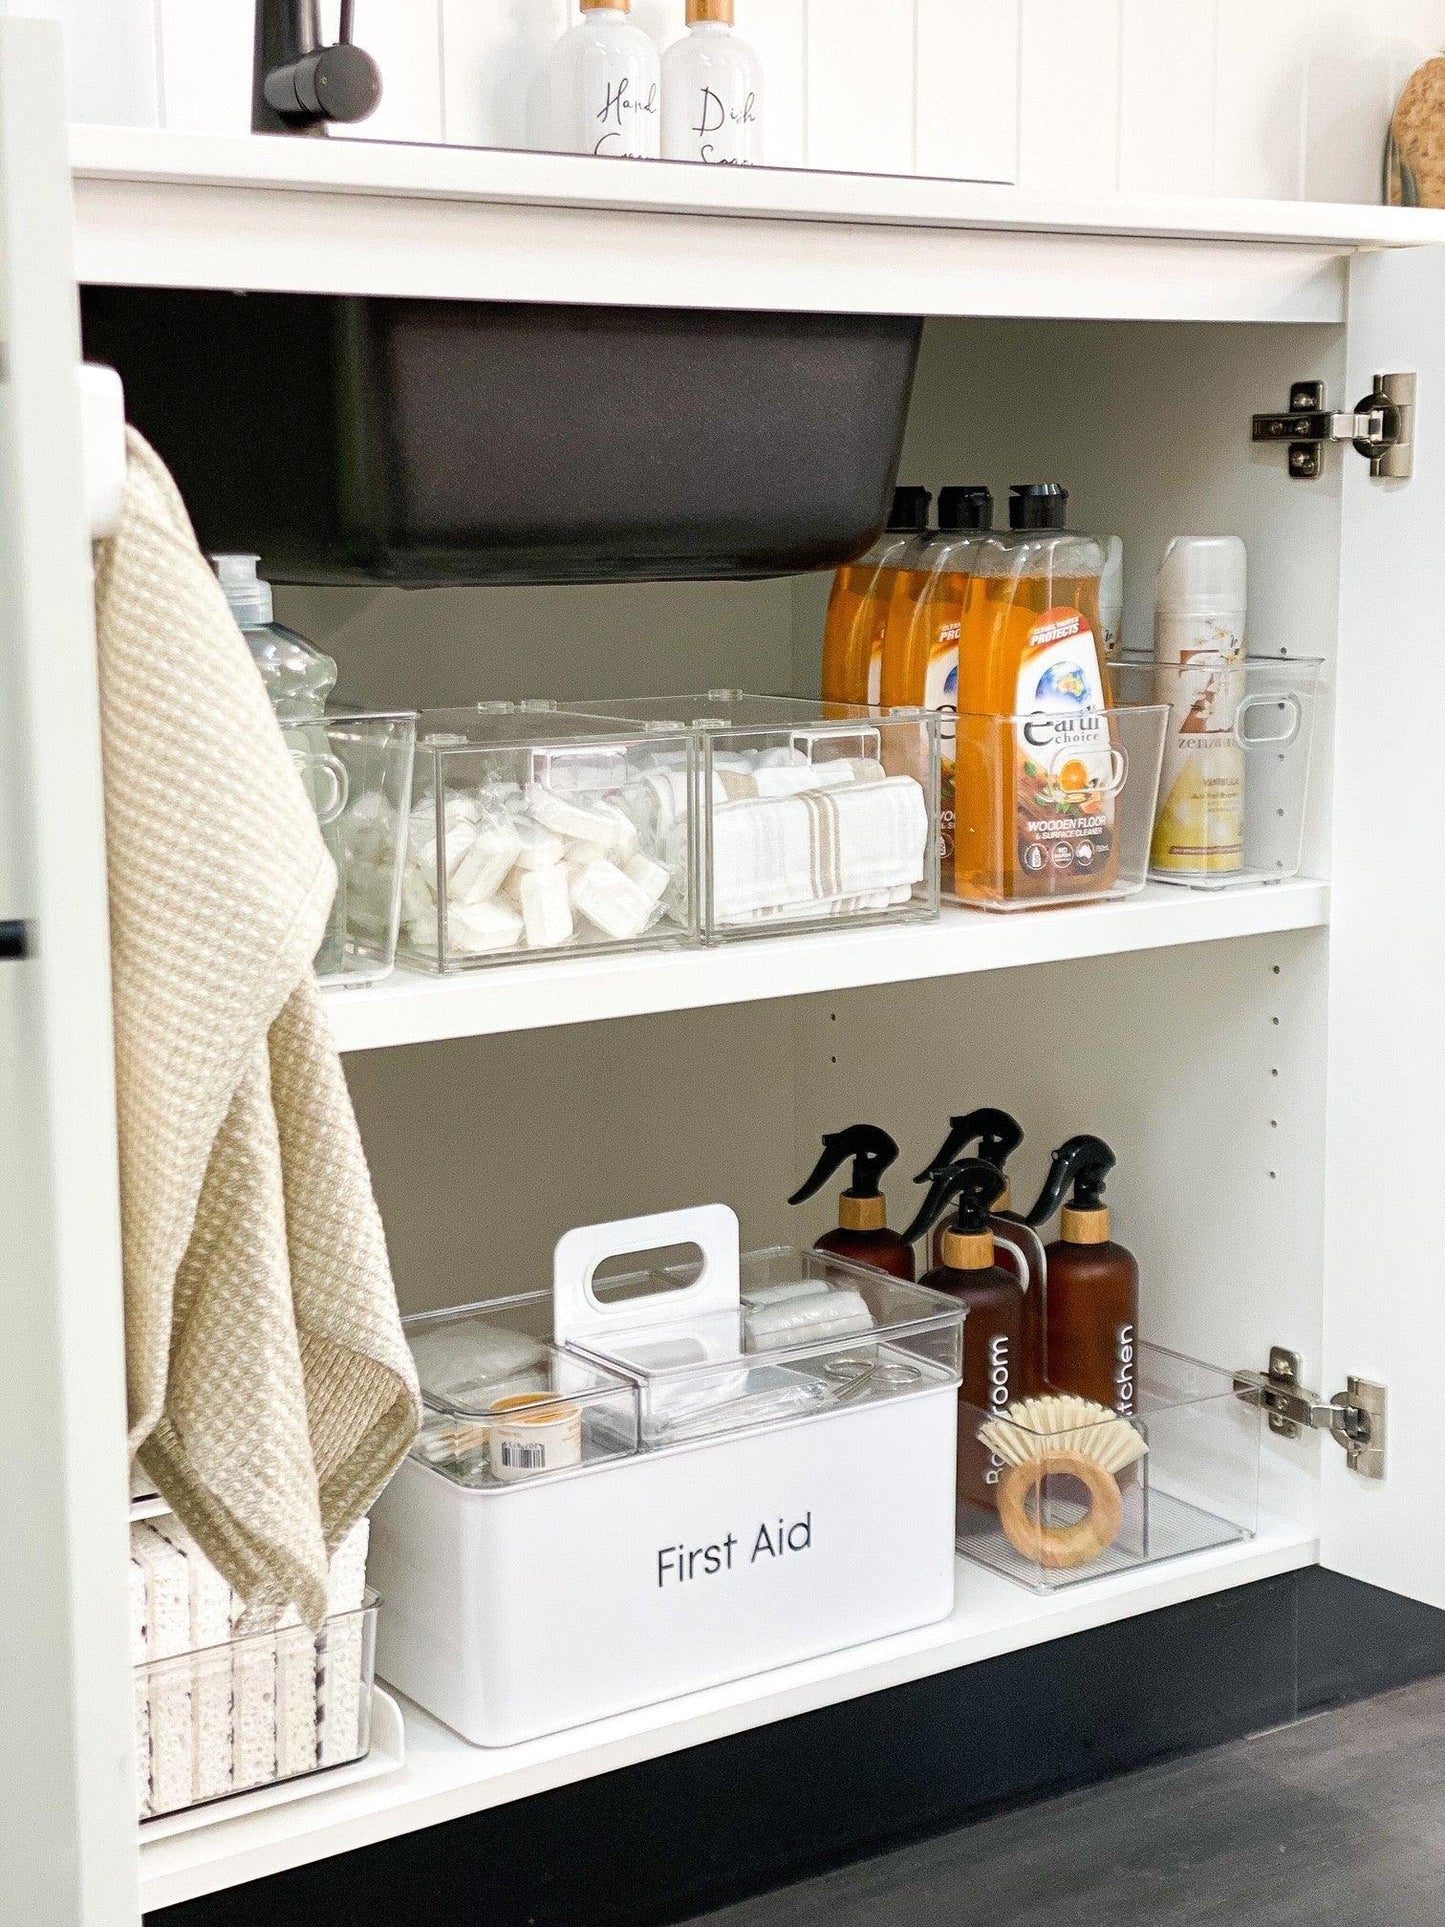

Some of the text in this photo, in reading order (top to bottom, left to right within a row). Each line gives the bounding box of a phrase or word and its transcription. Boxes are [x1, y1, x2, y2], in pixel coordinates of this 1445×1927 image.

[597, 78, 657, 125] Hand
[692, 86, 756, 137] Dish
[1031, 623, 1080, 646] PROTECTS
[1055, 732, 1099, 745] choice
[1028, 815, 1107, 831] WOODEN FLOOR
[1042, 830, 1074, 840] SURFACE
[1075, 827, 1103, 837] CLEANER
[1117, 1325, 1133, 1416] tchen
[658, 1511, 811, 1588] First Aid
